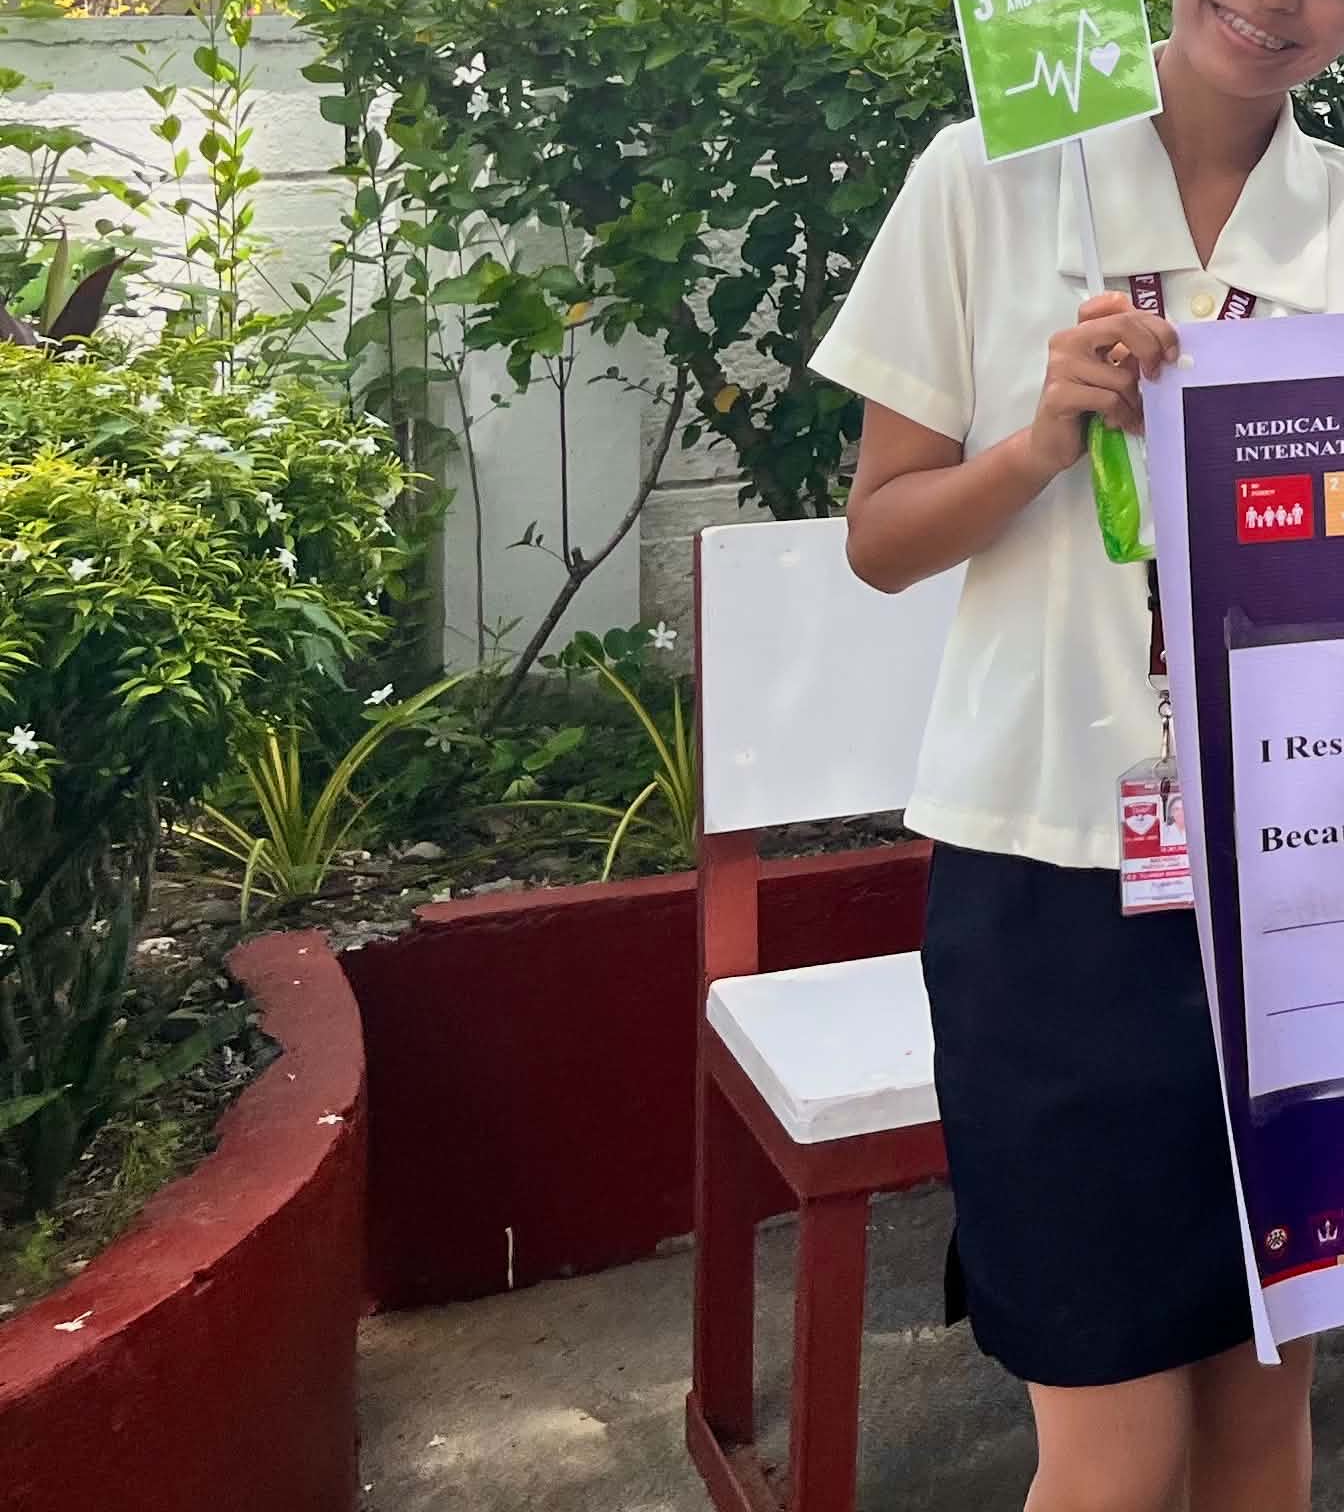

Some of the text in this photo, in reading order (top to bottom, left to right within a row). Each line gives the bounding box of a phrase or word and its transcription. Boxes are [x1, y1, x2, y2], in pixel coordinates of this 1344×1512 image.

[1234, 415, 1340, 439] MEDICAL
[1240, 483, 1248, 498] 1
[1329, 477, 1340, 490] 2
[1259, 738, 1272, 764] I
